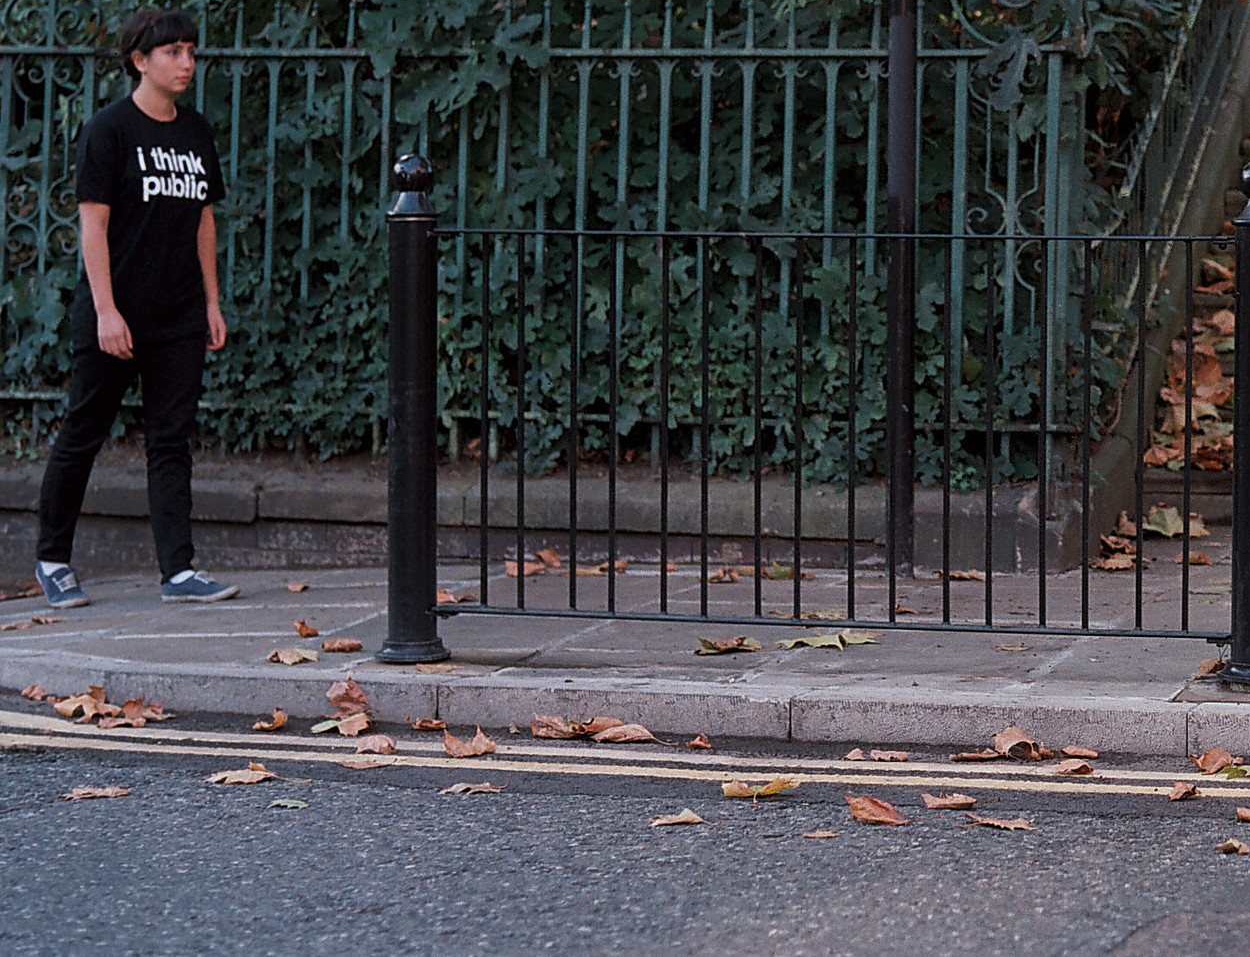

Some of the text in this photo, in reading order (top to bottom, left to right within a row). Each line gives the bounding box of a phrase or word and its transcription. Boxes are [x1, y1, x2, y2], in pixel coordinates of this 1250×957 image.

[136, 146, 206, 175] i think
[142, 173, 209, 202] public
